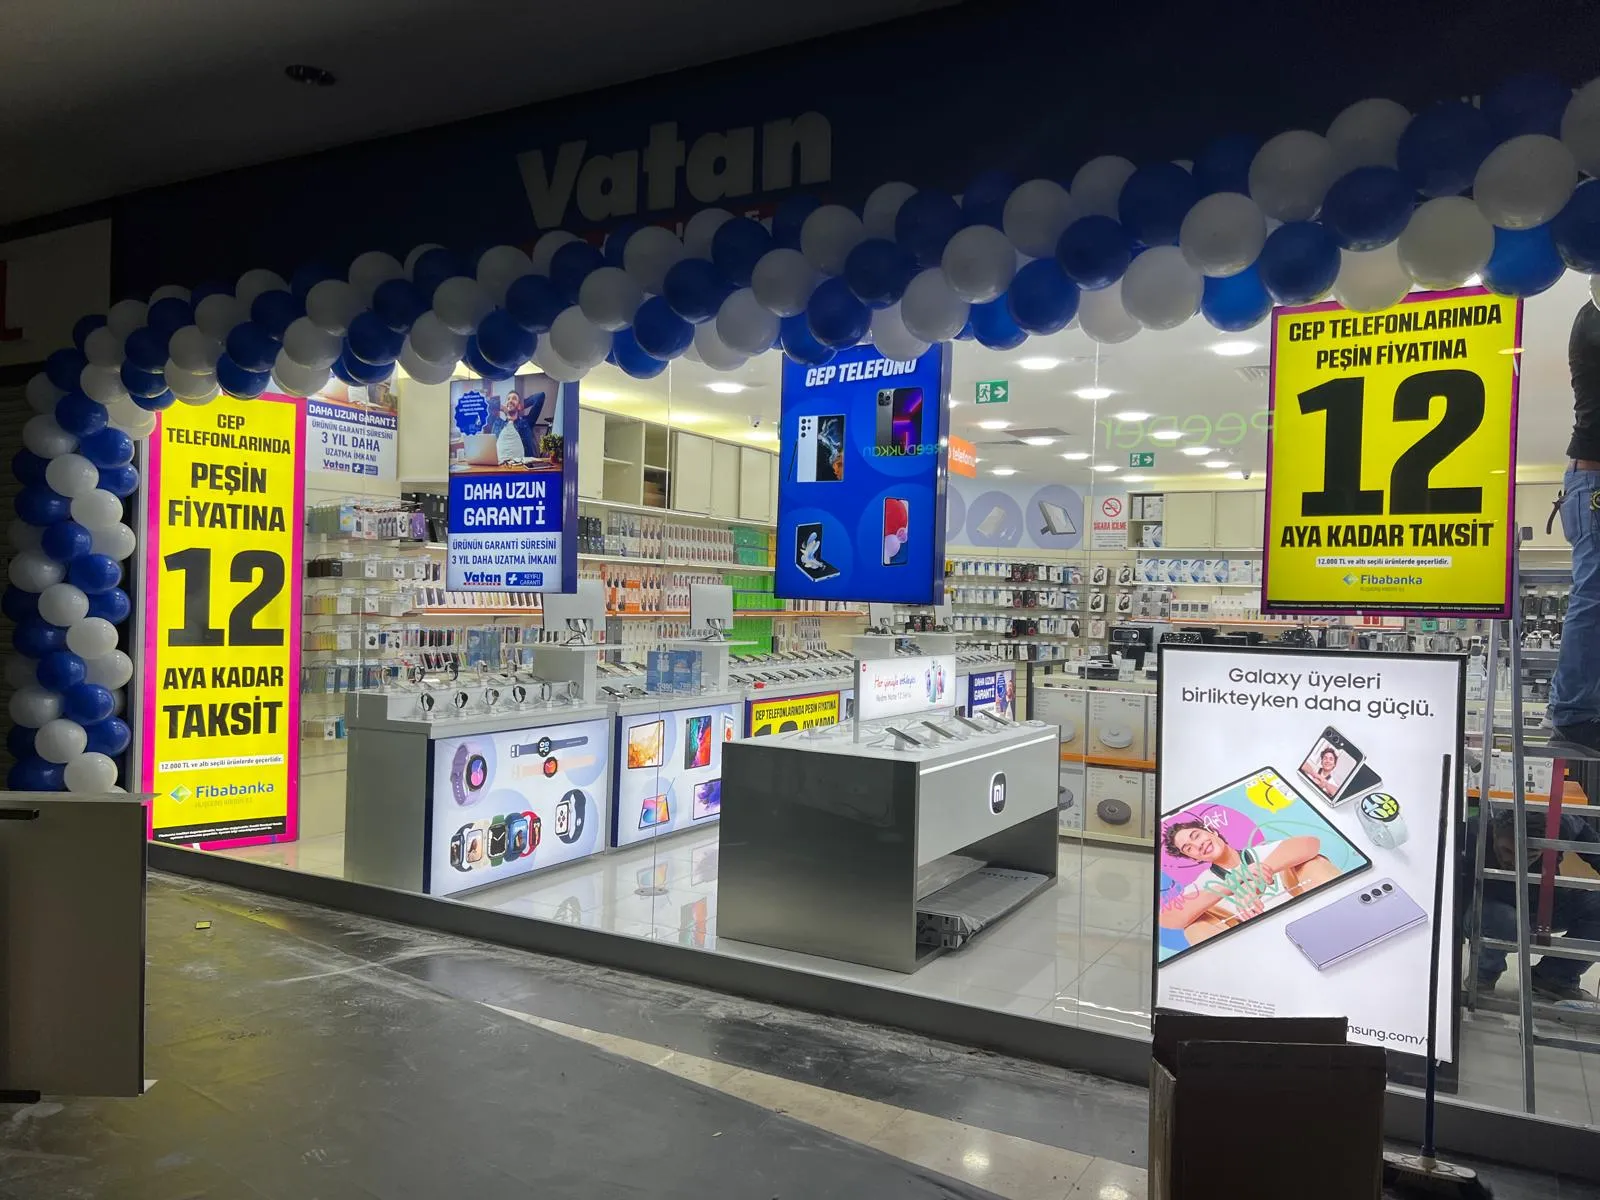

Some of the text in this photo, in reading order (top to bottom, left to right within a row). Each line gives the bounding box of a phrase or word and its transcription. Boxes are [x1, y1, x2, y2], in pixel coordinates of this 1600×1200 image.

[517, 110, 832, 230] Vatan
[1289, 304, 1502, 342] CEP TELEFONLARINDA
[1316, 339, 1467, 371] PEŞİN FİYATINA
[806, 365, 837, 387] CEP
[217, 413, 245, 430] CEP
[309, 404, 396, 428] DAHA UZUN GARANTİ
[167, 427, 291, 455] TELEFONLARINDA
[321, 431, 380, 452] 3 YIL DAHA
[1297, 369, 1485, 517] 12
[323, 459, 350, 470] Vatan
[325, 447, 352, 460] UZATMA
[191, 461, 267, 496] PEŞİN
[464, 481, 546, 500] DAHA UZUN
[168, 498, 286, 532] FİYATINA
[464, 501, 546, 526] GARANTİ
[453, 538, 556, 550] ÜRÜNÜN GARANTİ SÜRESİNİ
[1280, 519, 1494, 547] AYA KADAR TAKSİT
[452, 553, 556, 565] 3 YIL DAHA UZATMA İMKANI
[1367, 558, 1383, 566] seçili
[464, 572, 501, 583] Vatan
[1361, 574, 1423, 585] Fibabanka
[164, 547, 286, 647] 12
[163, 665, 284, 690] AYA KADAR
[1229, 667, 1381, 692] Galaxy üyeleri
[766, 705, 804, 719] TELEFONLARINDA
[1182, 687, 1434, 719] birlikteyken daha güçlü.
[163, 694, 283, 739] TAKSİT
[196, 781, 274, 798] Fibabanka
[1347, 1025, 1428, 1045] sung.com/
